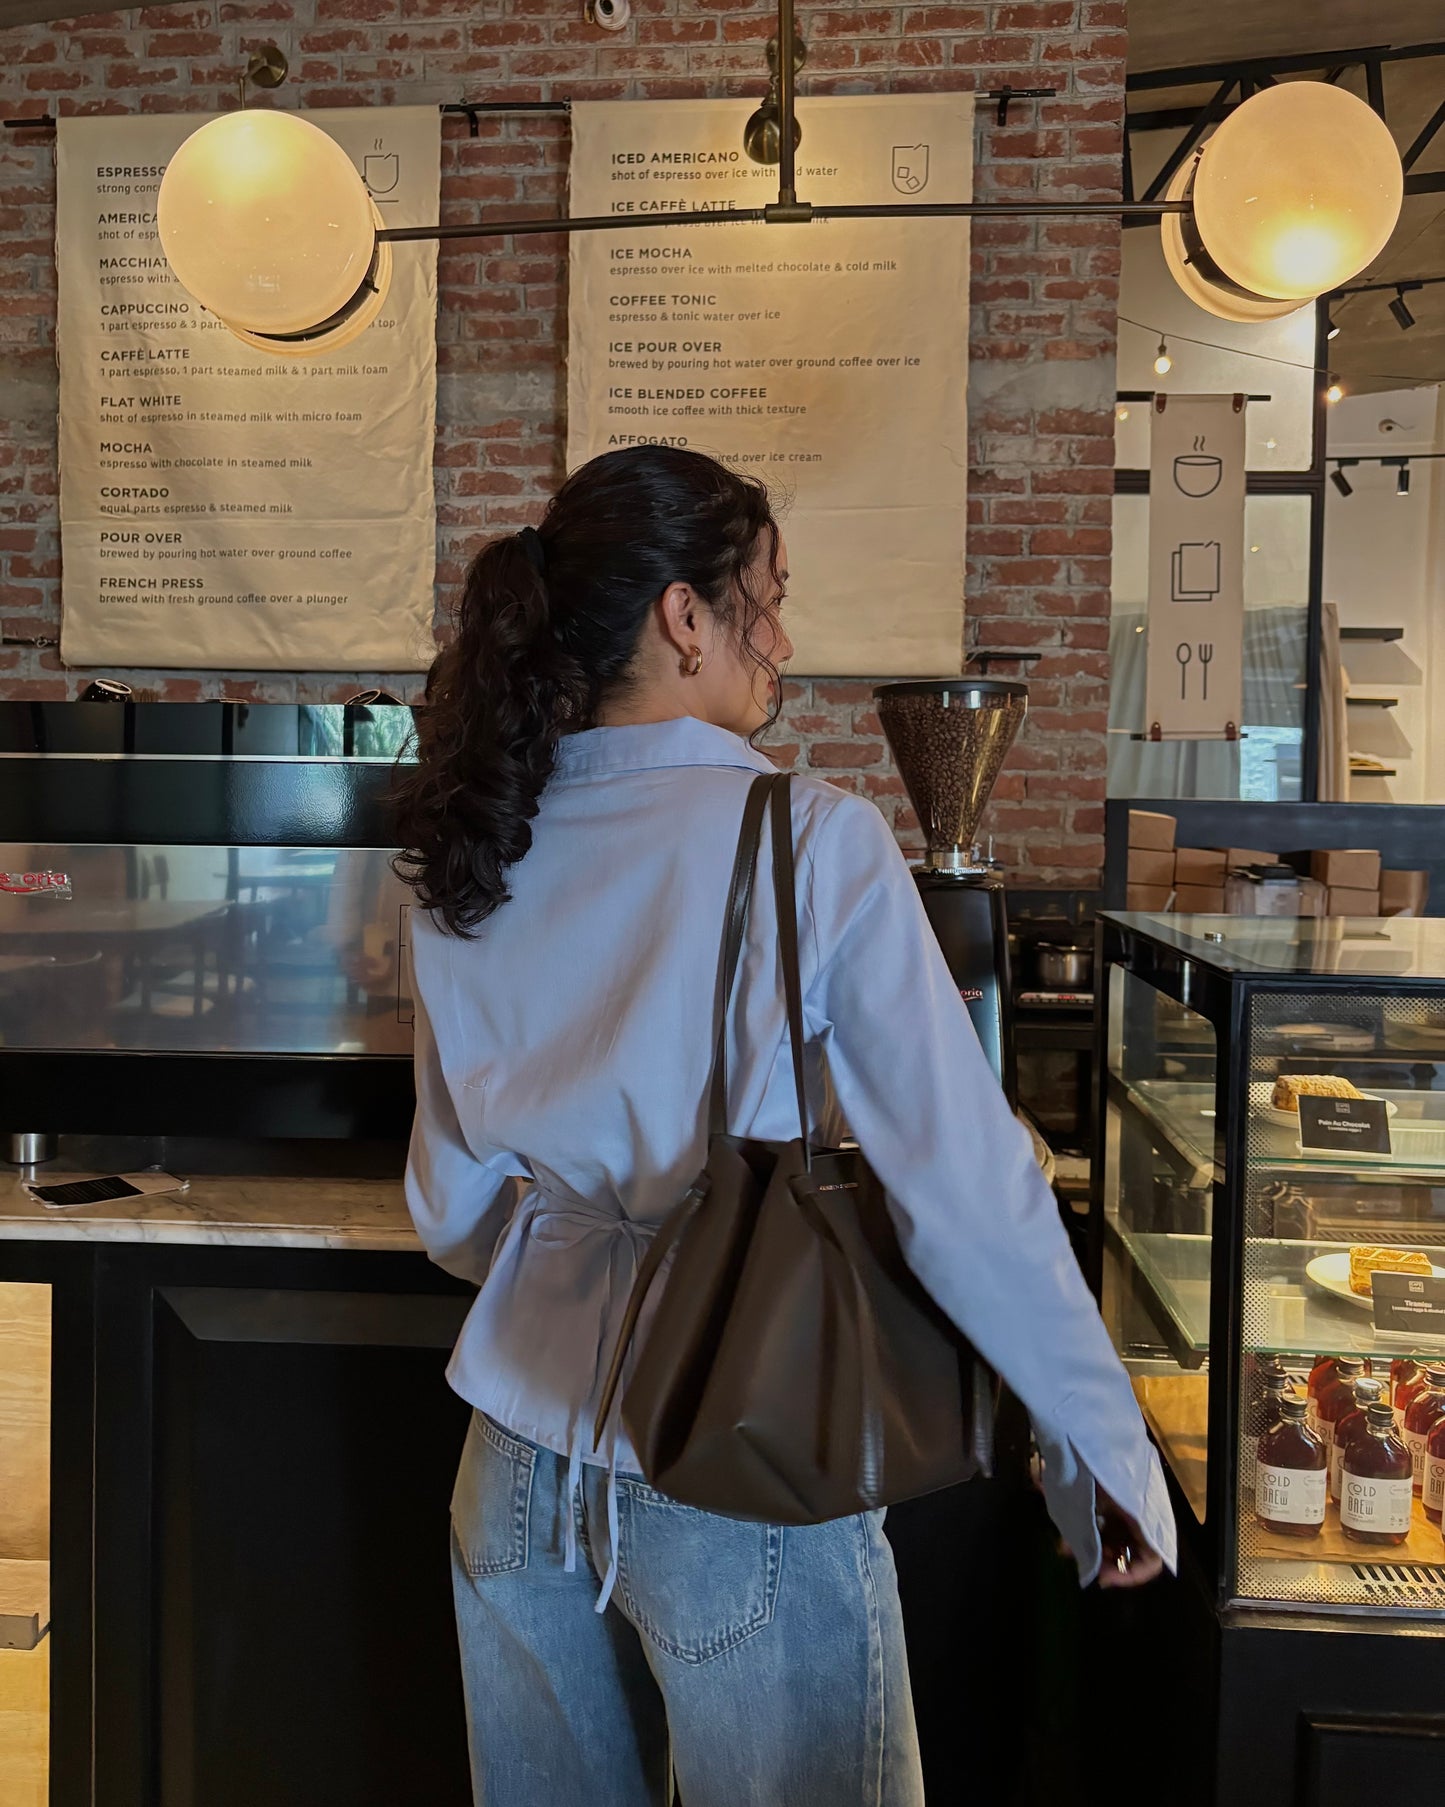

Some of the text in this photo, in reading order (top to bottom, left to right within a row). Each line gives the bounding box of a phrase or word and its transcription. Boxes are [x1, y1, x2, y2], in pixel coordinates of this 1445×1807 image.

[612, 151, 739, 165] ICED AMERICANO
[97, 166, 166, 178] ESPRESSO
[611, 170, 636, 181] shot
[638, 168, 650, 180] of
[652, 171, 702, 181] espresso
[704, 170, 729, 180] over
[732, 168, 748, 178] ice
[751, 167, 776, 178] with
[805, 167, 837, 176] water
[97, 184, 160, 195] strong conc
[611, 198, 737, 213] ICE CAFFÈ LATTE
[98, 230, 120, 240] shot
[123, 229, 135, 239] of
[610, 247, 692, 260] ICE MOCHA
[609, 260, 897, 277] espresso over ice with melted chocolate & cold milk
[99, 275, 144, 286] espresso
[146, 273, 171, 284] with
[609, 294, 716, 307] COFFEE TONIC
[100, 303, 190, 316] CAPPUCCINO
[608, 310, 781, 324] espresso & tonic water over ice
[100, 322, 106, 331] 1
[108, 321, 130, 333] part
[131, 320, 178, 333] espresso
[179, 319, 188, 329] &
[190, 319, 198, 329] 3
[200, 319, 228, 330] part
[378, 319, 396, 329] top
[609, 341, 722, 353] ICE POUR OVER
[100, 348, 190, 362] CAFFÈ LATTE
[608, 356, 921, 372] brewed by pouring hot water over ground coffee over ice
[100, 367, 105, 377] 1
[108, 367, 131, 379] part
[182, 365, 188, 375] 1
[191, 366, 213, 376] part
[217, 366, 263, 377] steamed
[265, 365, 288, 376] milk
[291, 366, 299, 376] &
[302, 366, 307, 375] 1
[311, 367, 333, 377] part
[336, 365, 359, 376] milk
[361, 365, 388, 375] foam
[609, 387, 767, 400] ICE BLENDED COFFEE
[100, 395, 181, 408] FLAT WHITE
[608, 404, 807, 416] smooth ice coffee with thick texture
[99, 411, 362, 424] shot of espresso in steamed milk with micro foam
[608, 434, 688, 447] AFFOGATO
[100, 442, 152, 454] MOCHA
[99, 456, 313, 470] espresso with chocolate in steamed milk
[741, 453, 766, 463] over
[769, 452, 785, 462] ice
[788, 453, 822, 462] cream
[100, 487, 169, 499] CORTADO
[99, 503, 293, 516] equal parts espresso & steamed milk
[100, 532, 182, 544] POUR OVER
[99, 548, 352, 561] brewed by pouring hot water over ground coffee
[100, 577, 204, 589] FRENCH PRESS
[99, 593, 348, 606] brewed with fresh ground coffee over a plunger
[1262, 1472, 1291, 1488] COLD
[1346, 1481, 1377, 1498] COLD
[1347, 1495, 1374, 1516] BREW
